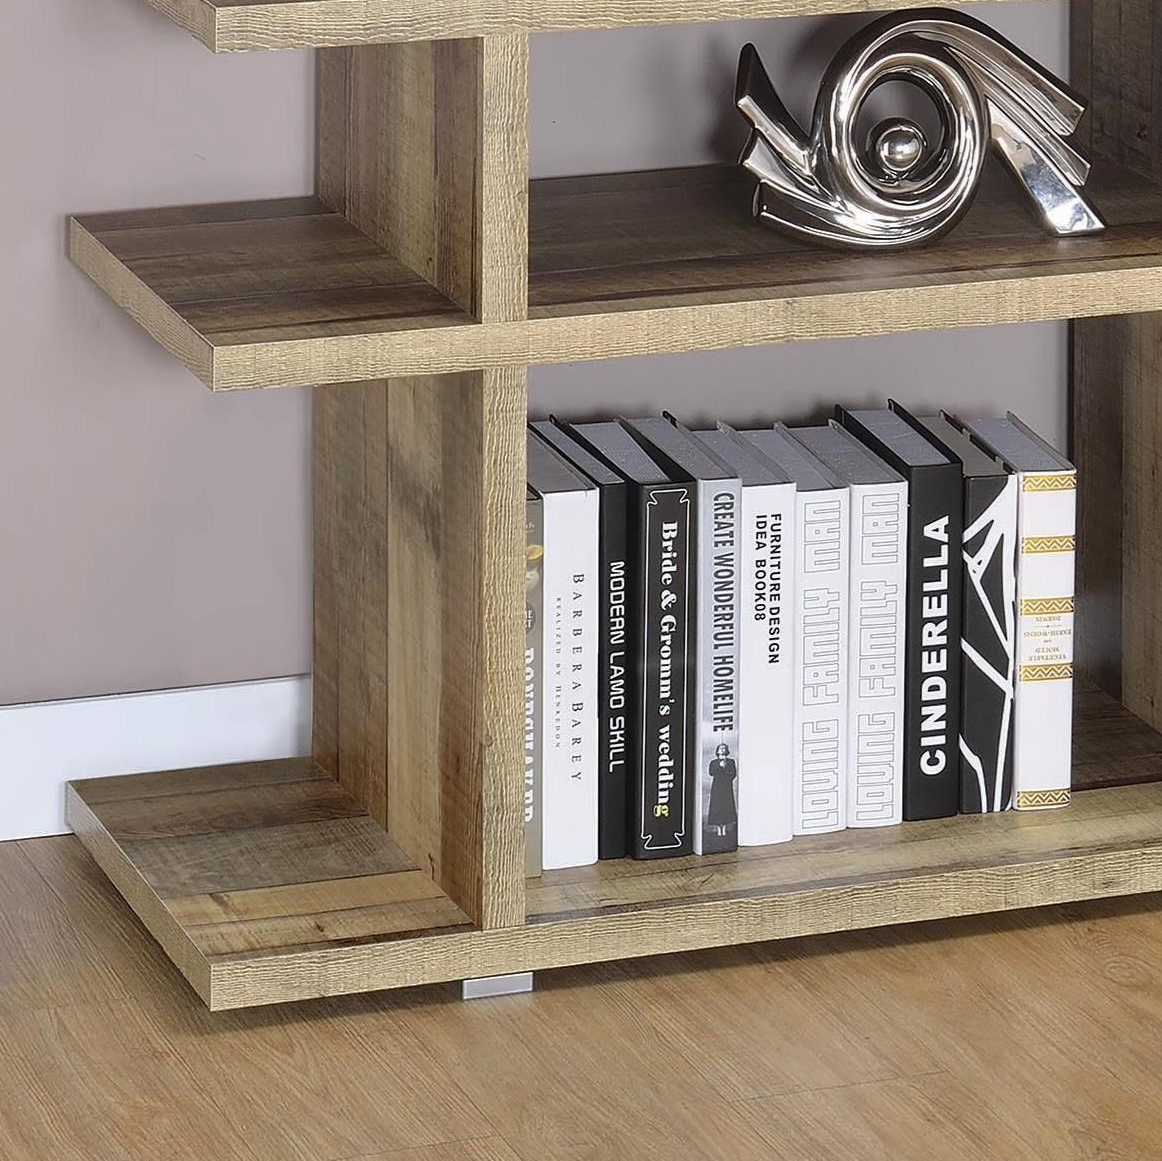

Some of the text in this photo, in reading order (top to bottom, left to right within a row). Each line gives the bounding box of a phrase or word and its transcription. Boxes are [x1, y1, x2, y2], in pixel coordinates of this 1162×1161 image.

[660, 520, 678, 585] Bride
[754, 515, 767, 621] IDEA BOOK08
[804, 500, 841, 573] MAN
[861, 492, 899, 566] MAN
[660, 590, 677, 610] &
[712, 492, 735, 732] CREATE WONDERFUL HOMELIFE
[767, 513, 782, 665] FURNITURE DESIGN
[803, 587, 841, 706] FAMILY
[858, 580, 898, 699] FAMILY
[920, 515, 950, 776] CINDERELLA
[571, 573, 585, 781] BARBERA BAREY
[608, 561, 626, 773] MODERN LAMO SKILL
[653, 725, 674, 818] wedding
